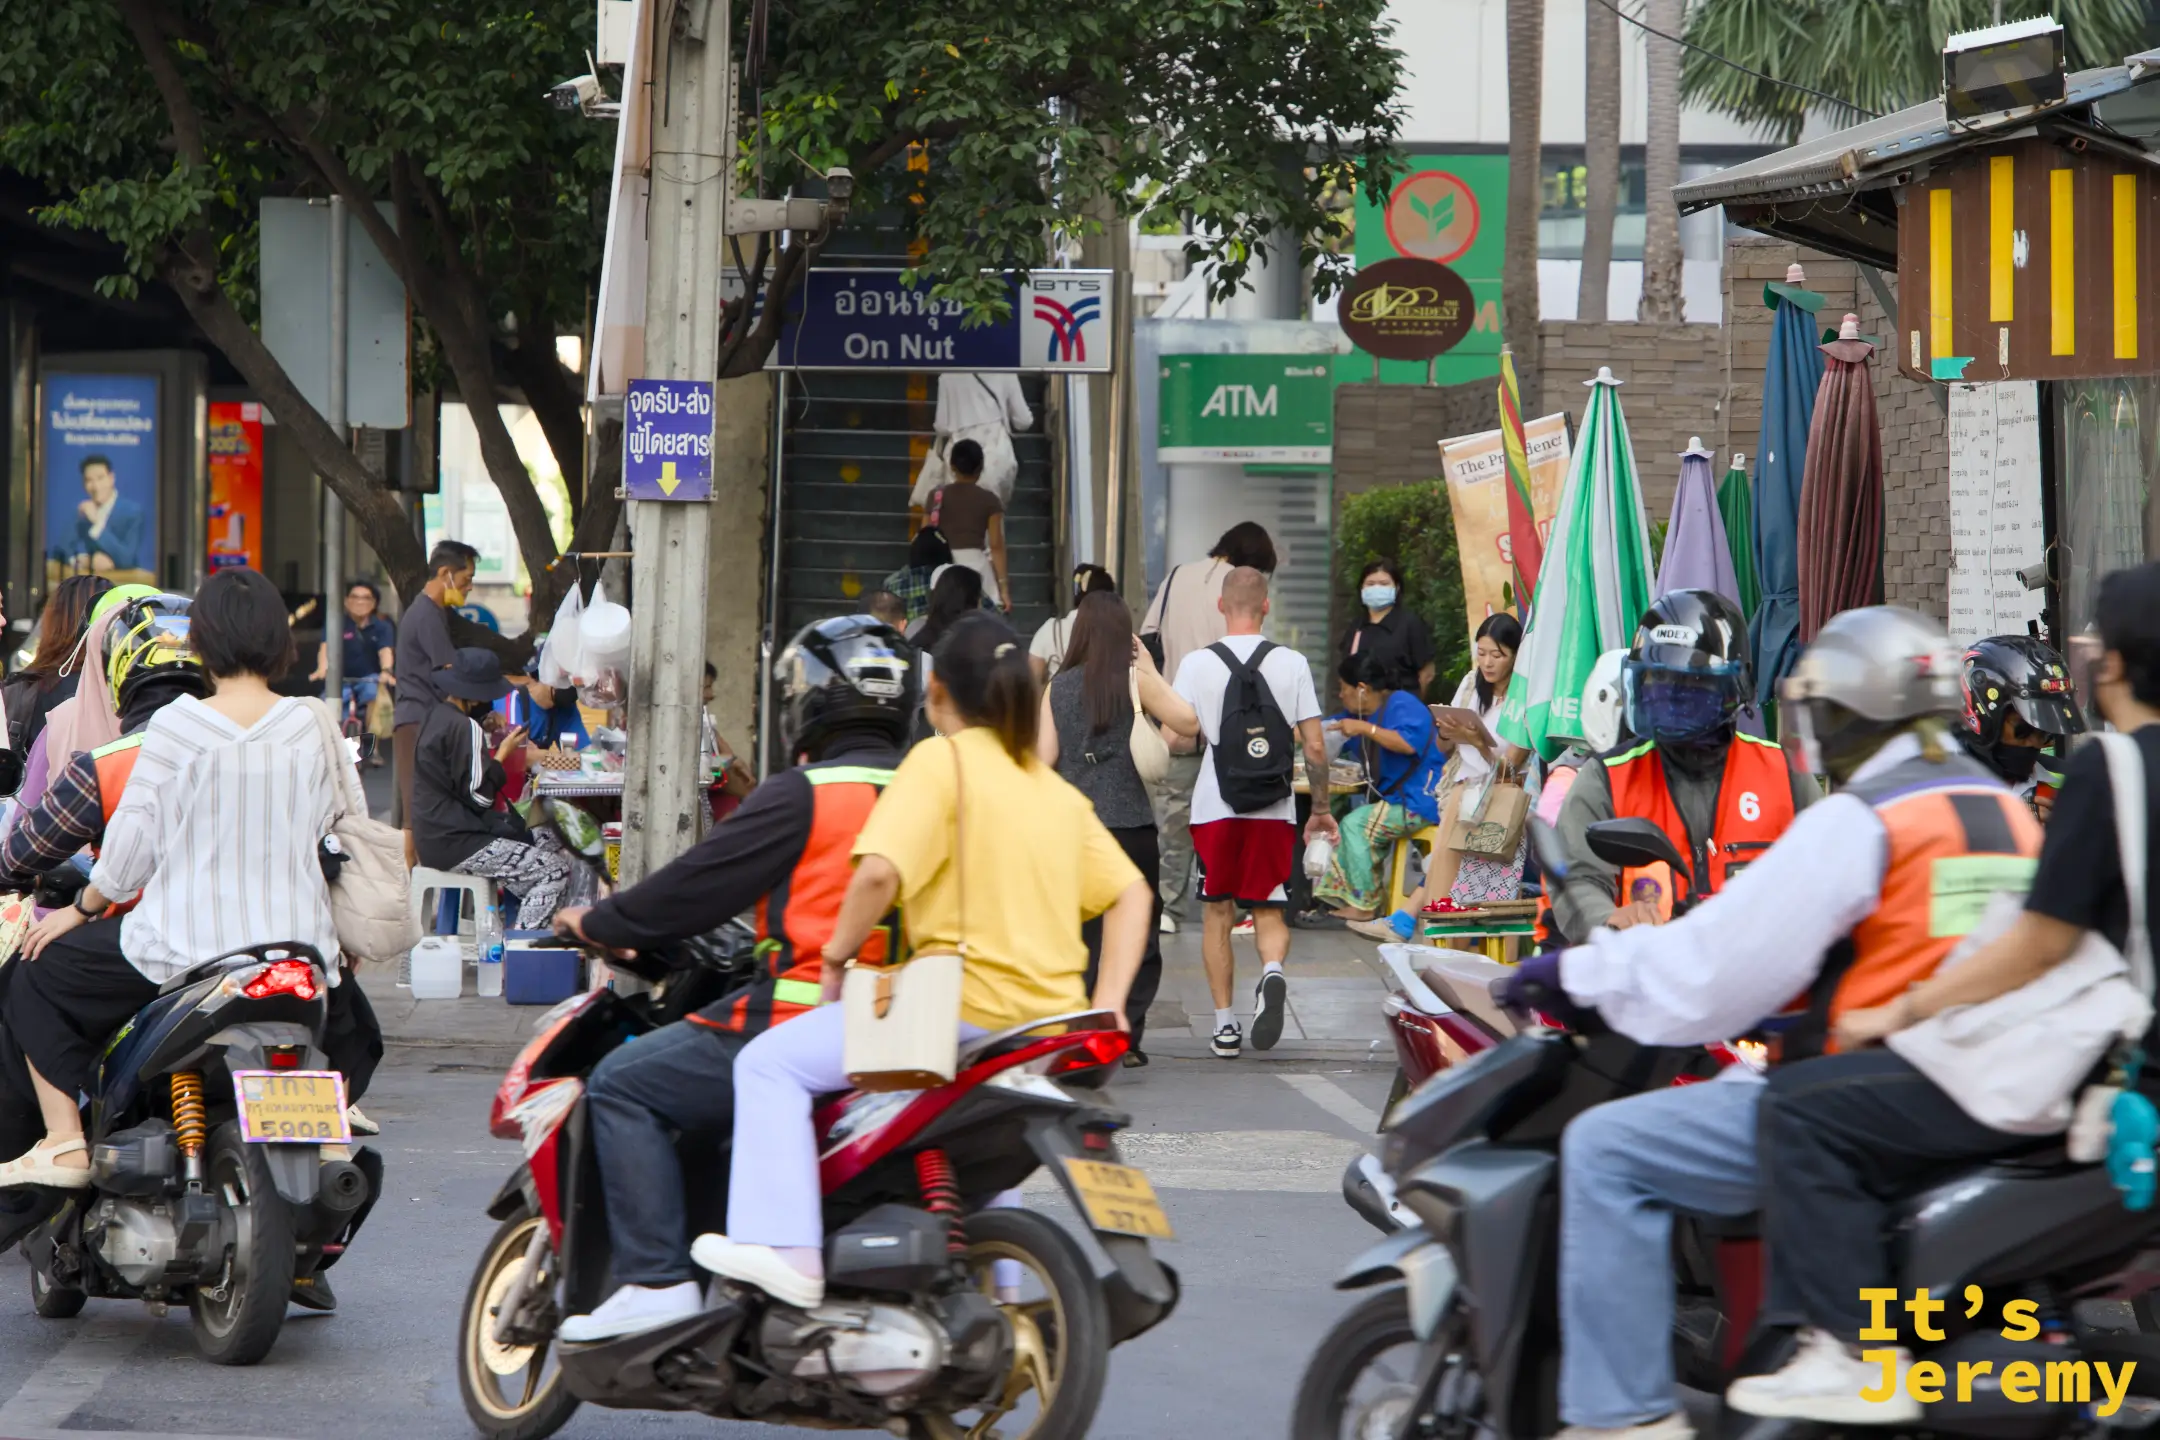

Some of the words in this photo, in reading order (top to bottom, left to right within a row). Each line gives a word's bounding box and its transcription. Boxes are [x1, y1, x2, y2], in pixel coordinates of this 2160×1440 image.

[1033, 279, 1100, 291] BTS
[844, 333, 888, 360] On
[901, 333, 955, 360] Nut
[629, 385, 710, 422] จุดรับ-ส่ง
[1201, 383, 1278, 417] ATM
[629, 421, 710, 464] ผู้โดยสาร
[1457, 460, 1485, 475] The
[1656, 627, 1690, 640] INDEX
[1738, 791, 1761, 822] 6
